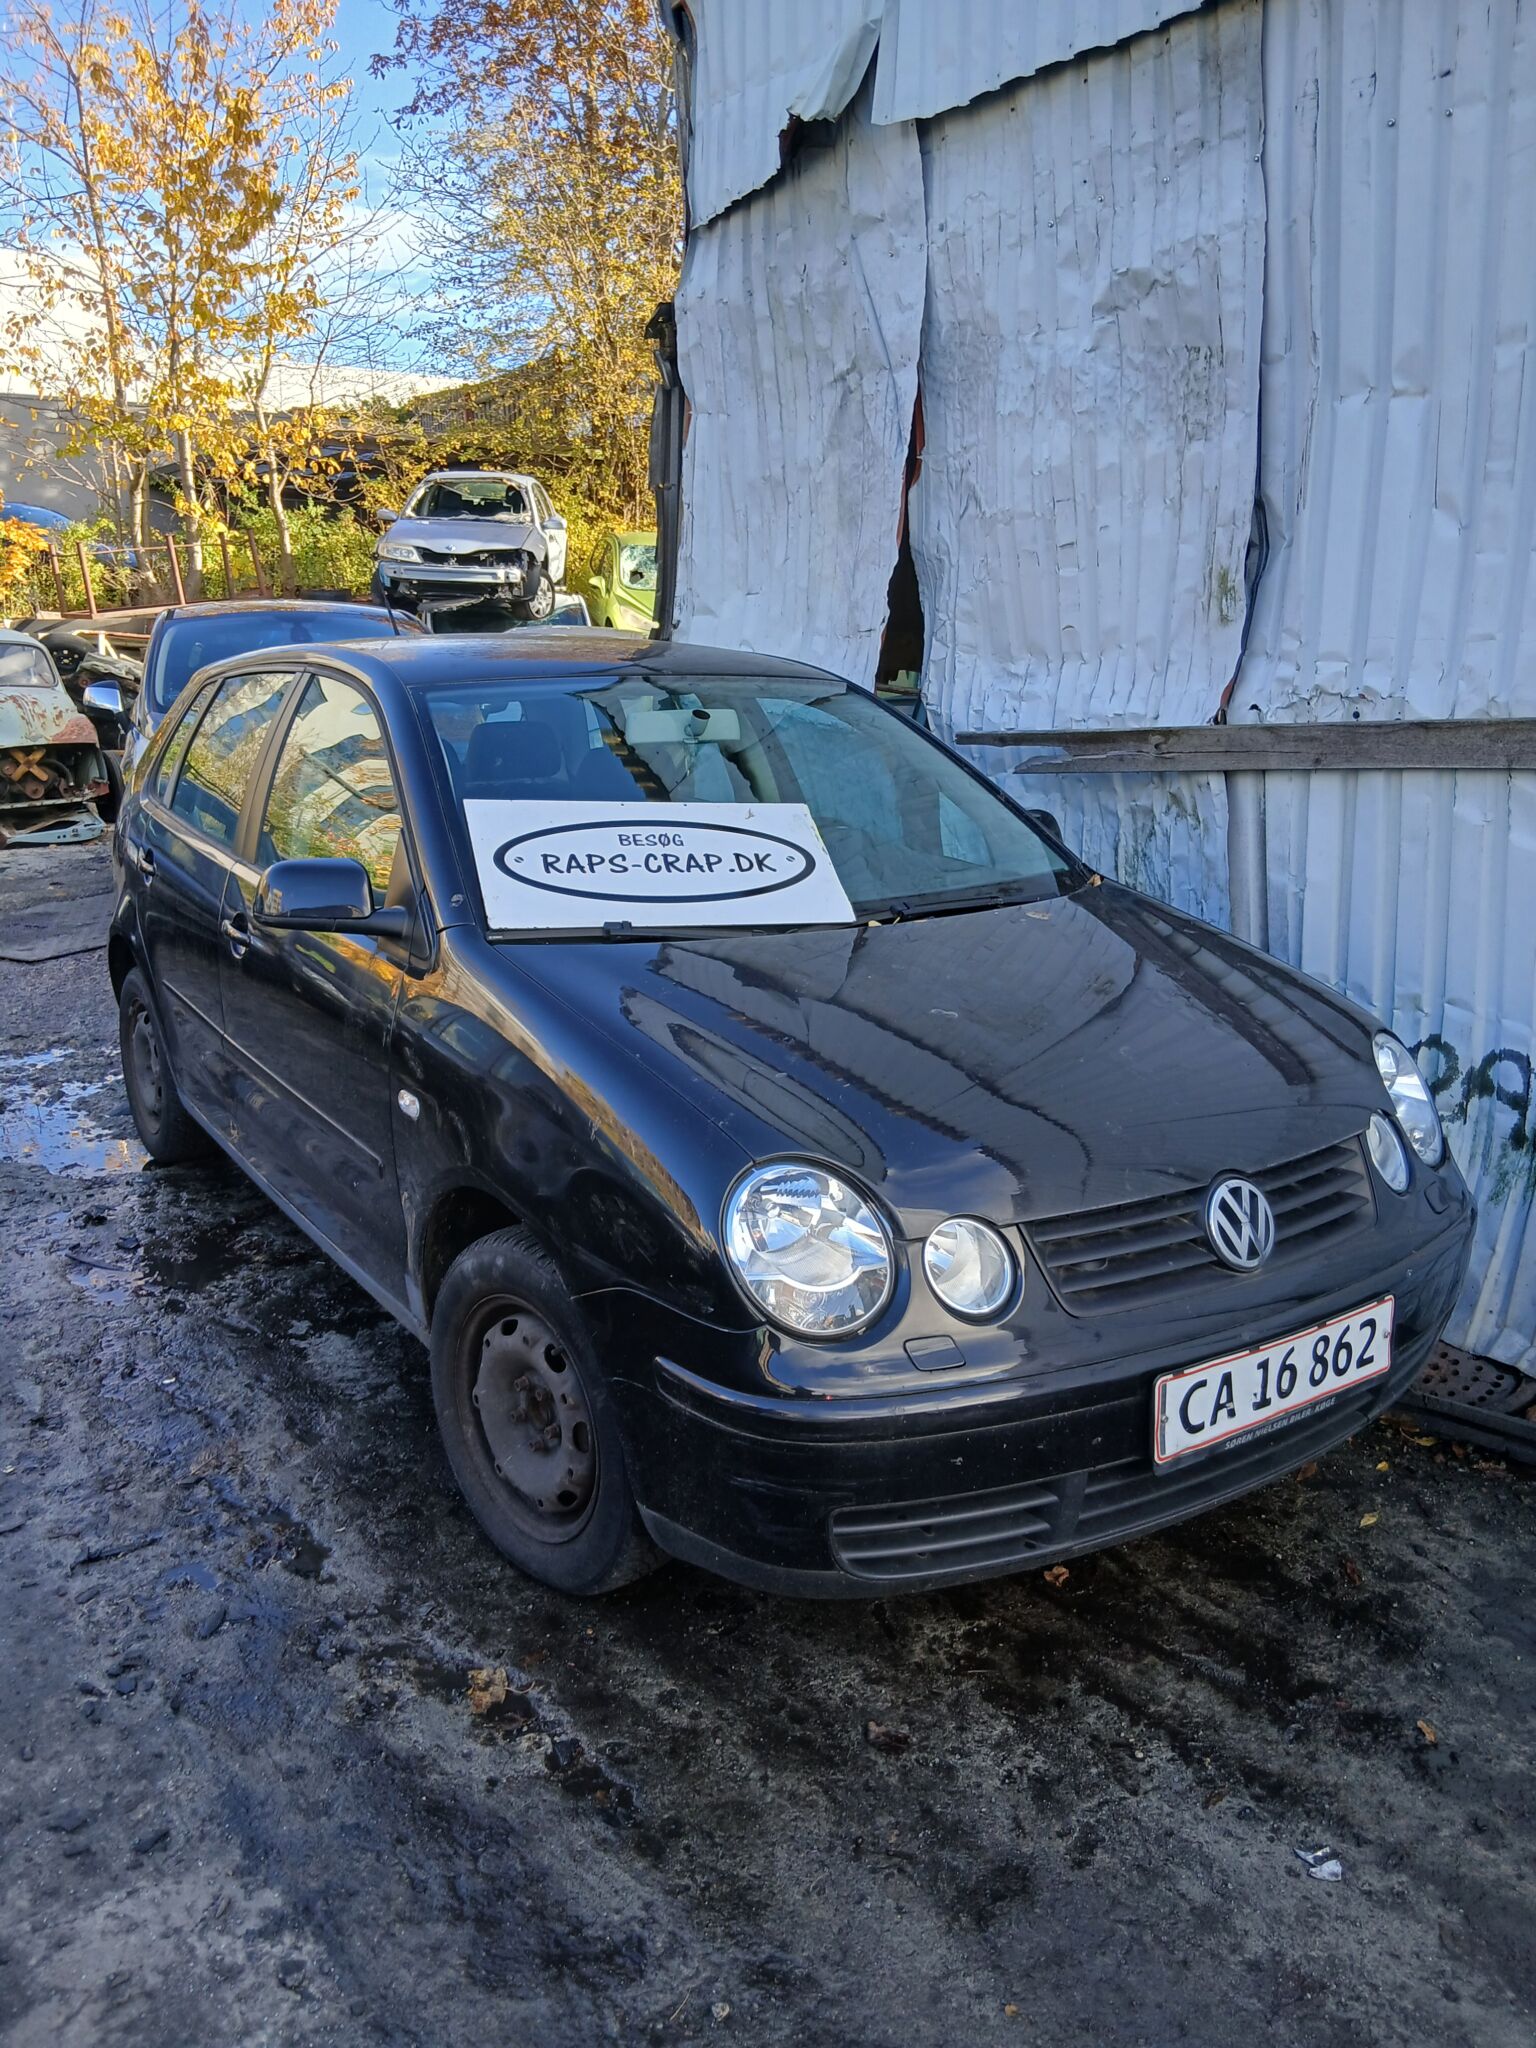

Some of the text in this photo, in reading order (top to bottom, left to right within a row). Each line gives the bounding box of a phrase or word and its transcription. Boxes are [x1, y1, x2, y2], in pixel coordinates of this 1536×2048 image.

[617, 833, 685, 848] BESØG
[541, 852, 777, 874] RAPS-CRAP.DK
[1179, 1317, 1377, 1434] CA 16 862
